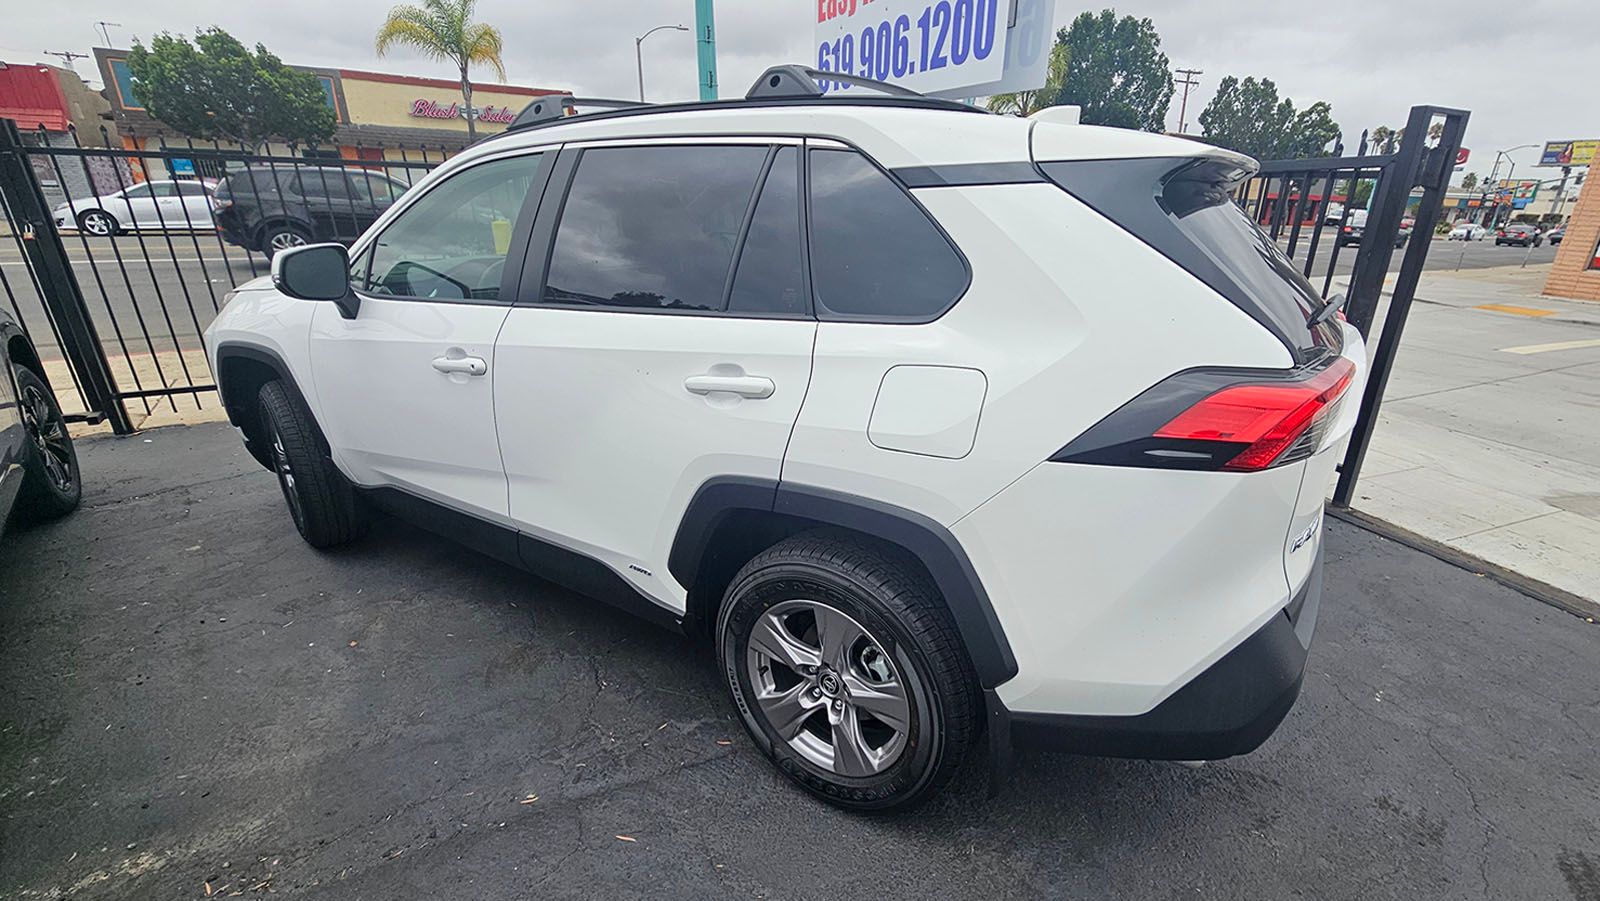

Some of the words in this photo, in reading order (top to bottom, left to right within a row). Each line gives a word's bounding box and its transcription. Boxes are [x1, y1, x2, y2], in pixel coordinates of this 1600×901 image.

[818, 0, 998, 94] 619906.1200
[409, 99, 459, 120] Blush
[480, 105, 515, 123] Salo
